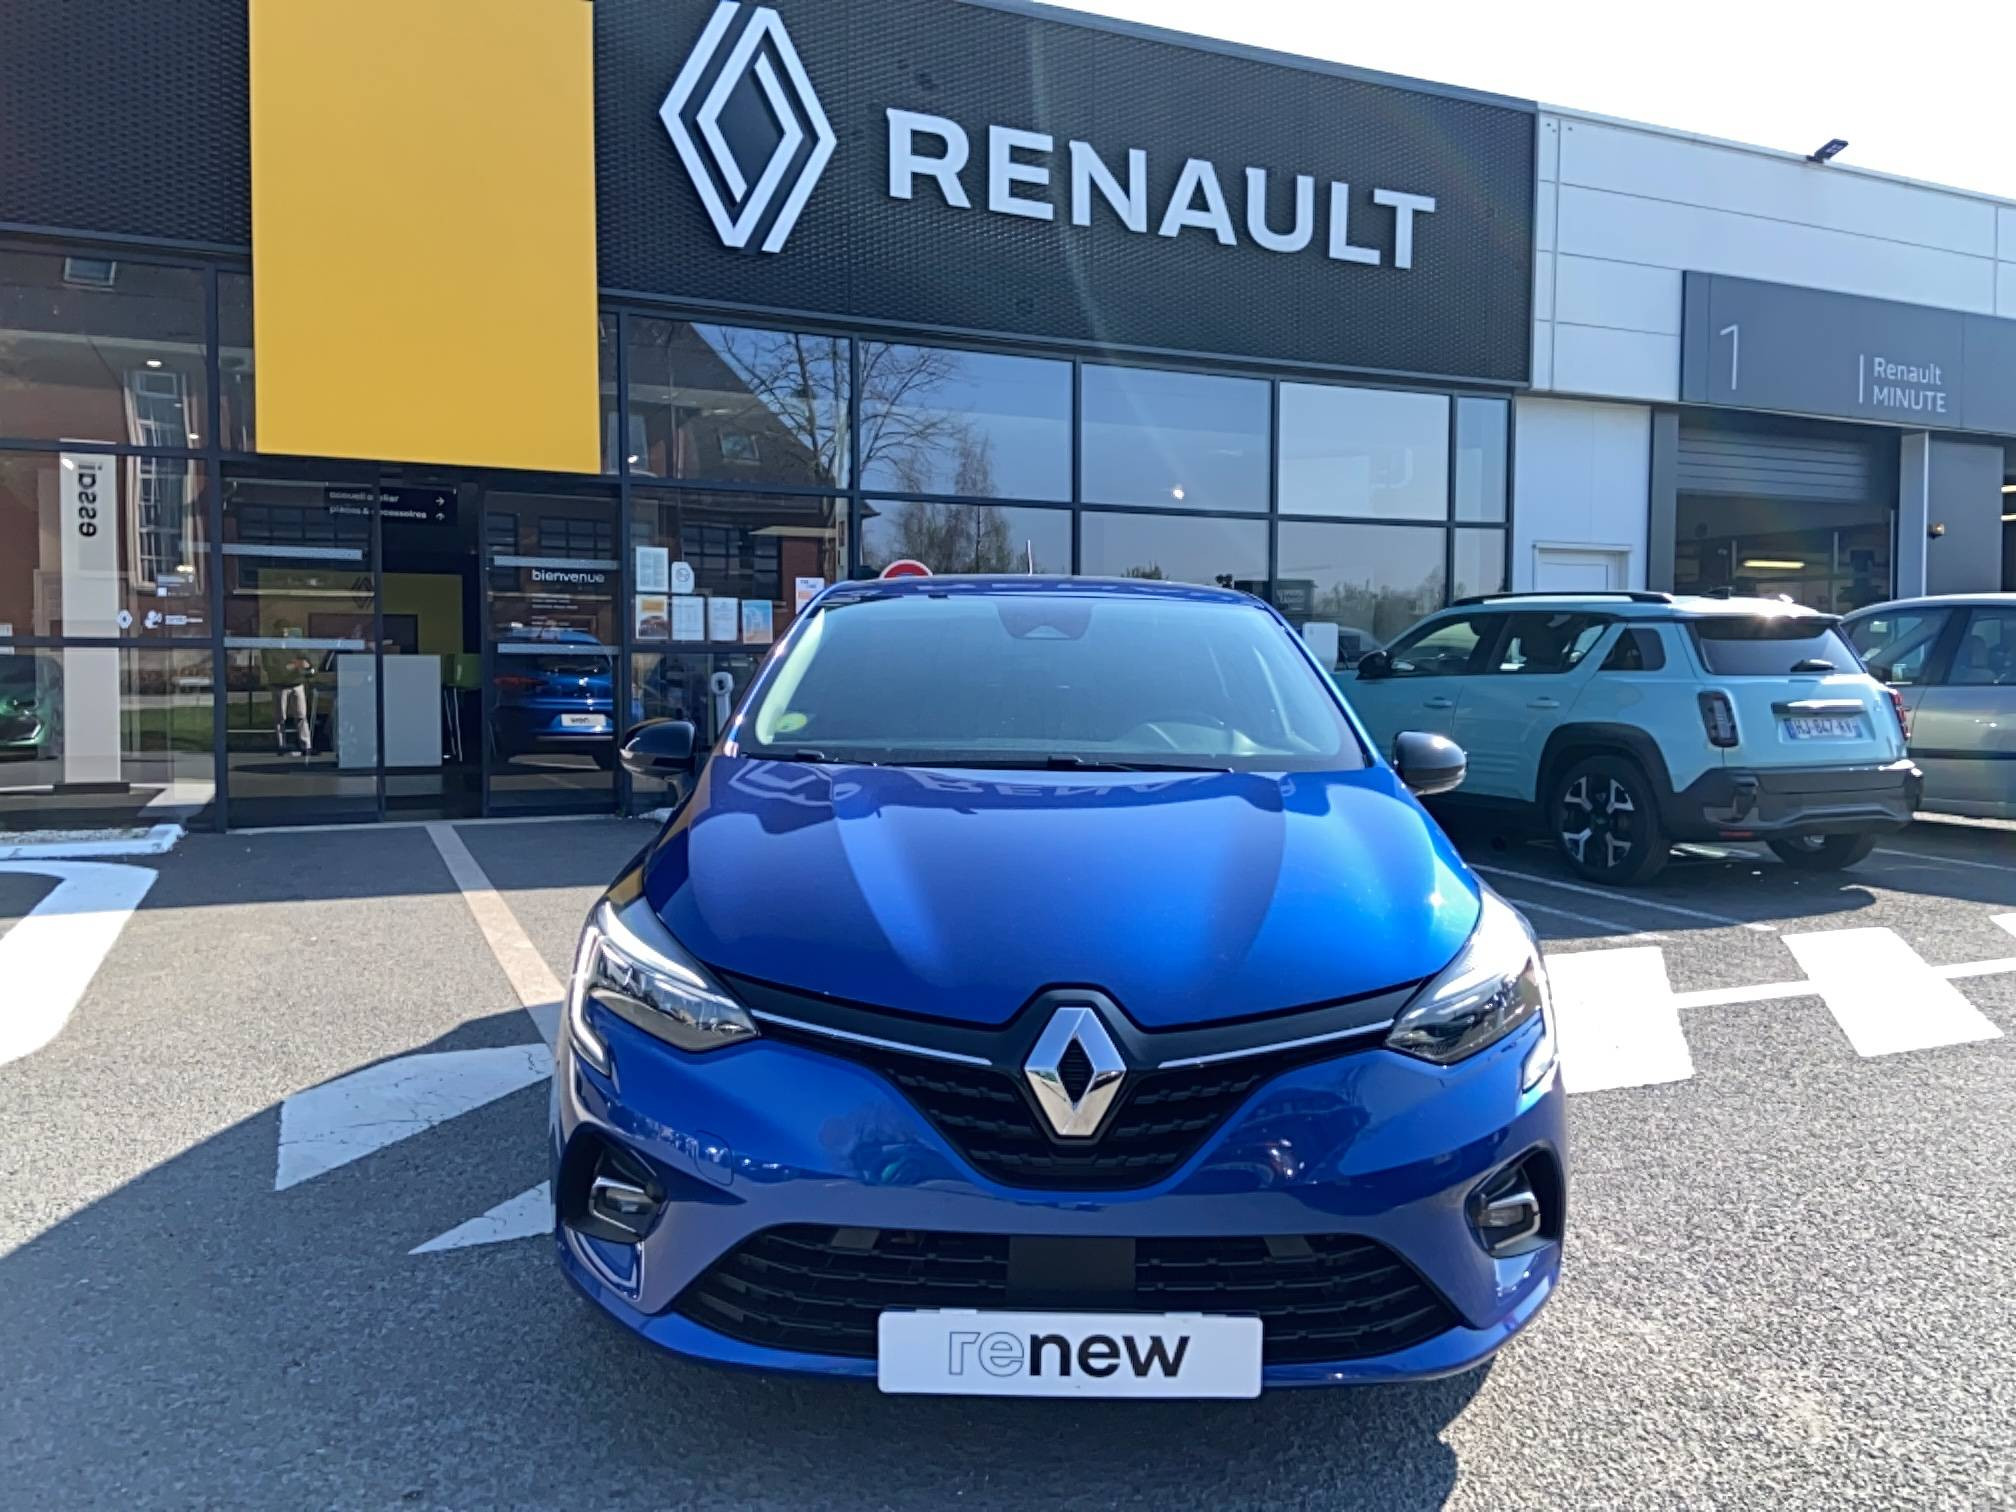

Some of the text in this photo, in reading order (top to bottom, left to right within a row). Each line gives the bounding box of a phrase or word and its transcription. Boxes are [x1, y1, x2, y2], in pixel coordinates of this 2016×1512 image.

[886, 107, 1436, 270] RENAULT
[1719, 324, 1739, 391] 1
[1873, 357, 1942, 385] Renault
[1872, 385, 1947, 413] MINUTE
[532, 568, 605, 583] bienvenue
[949, 1331, 1190, 1378] renew
